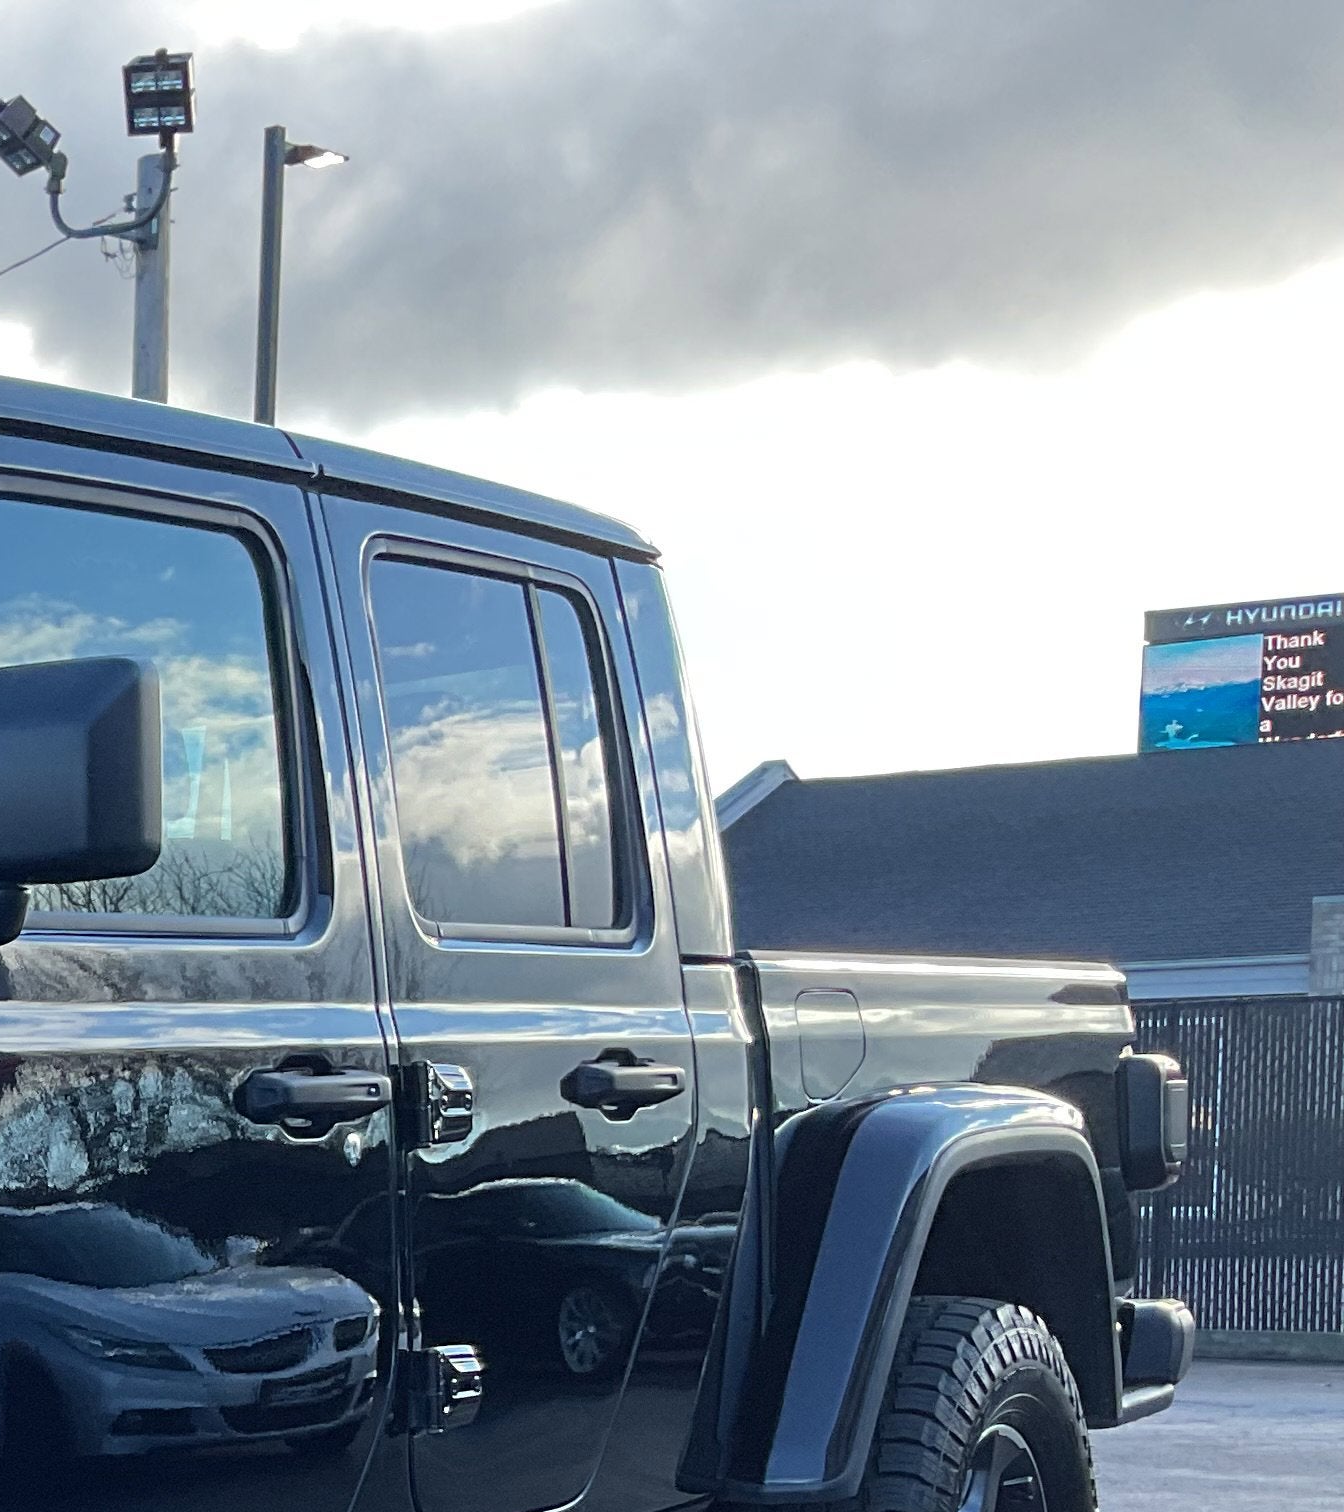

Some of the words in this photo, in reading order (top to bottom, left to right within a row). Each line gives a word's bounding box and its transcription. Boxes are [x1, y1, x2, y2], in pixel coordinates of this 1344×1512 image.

[1226, 600, 1342, 626] HYUNDAI
[1263, 630, 1326, 651] Thank
[1263, 655, 1301, 671] You
[1263, 671, 1325, 691] Skagit
[1261, 695, 1320, 712] Valley
[1259, 719, 1272, 732] a
